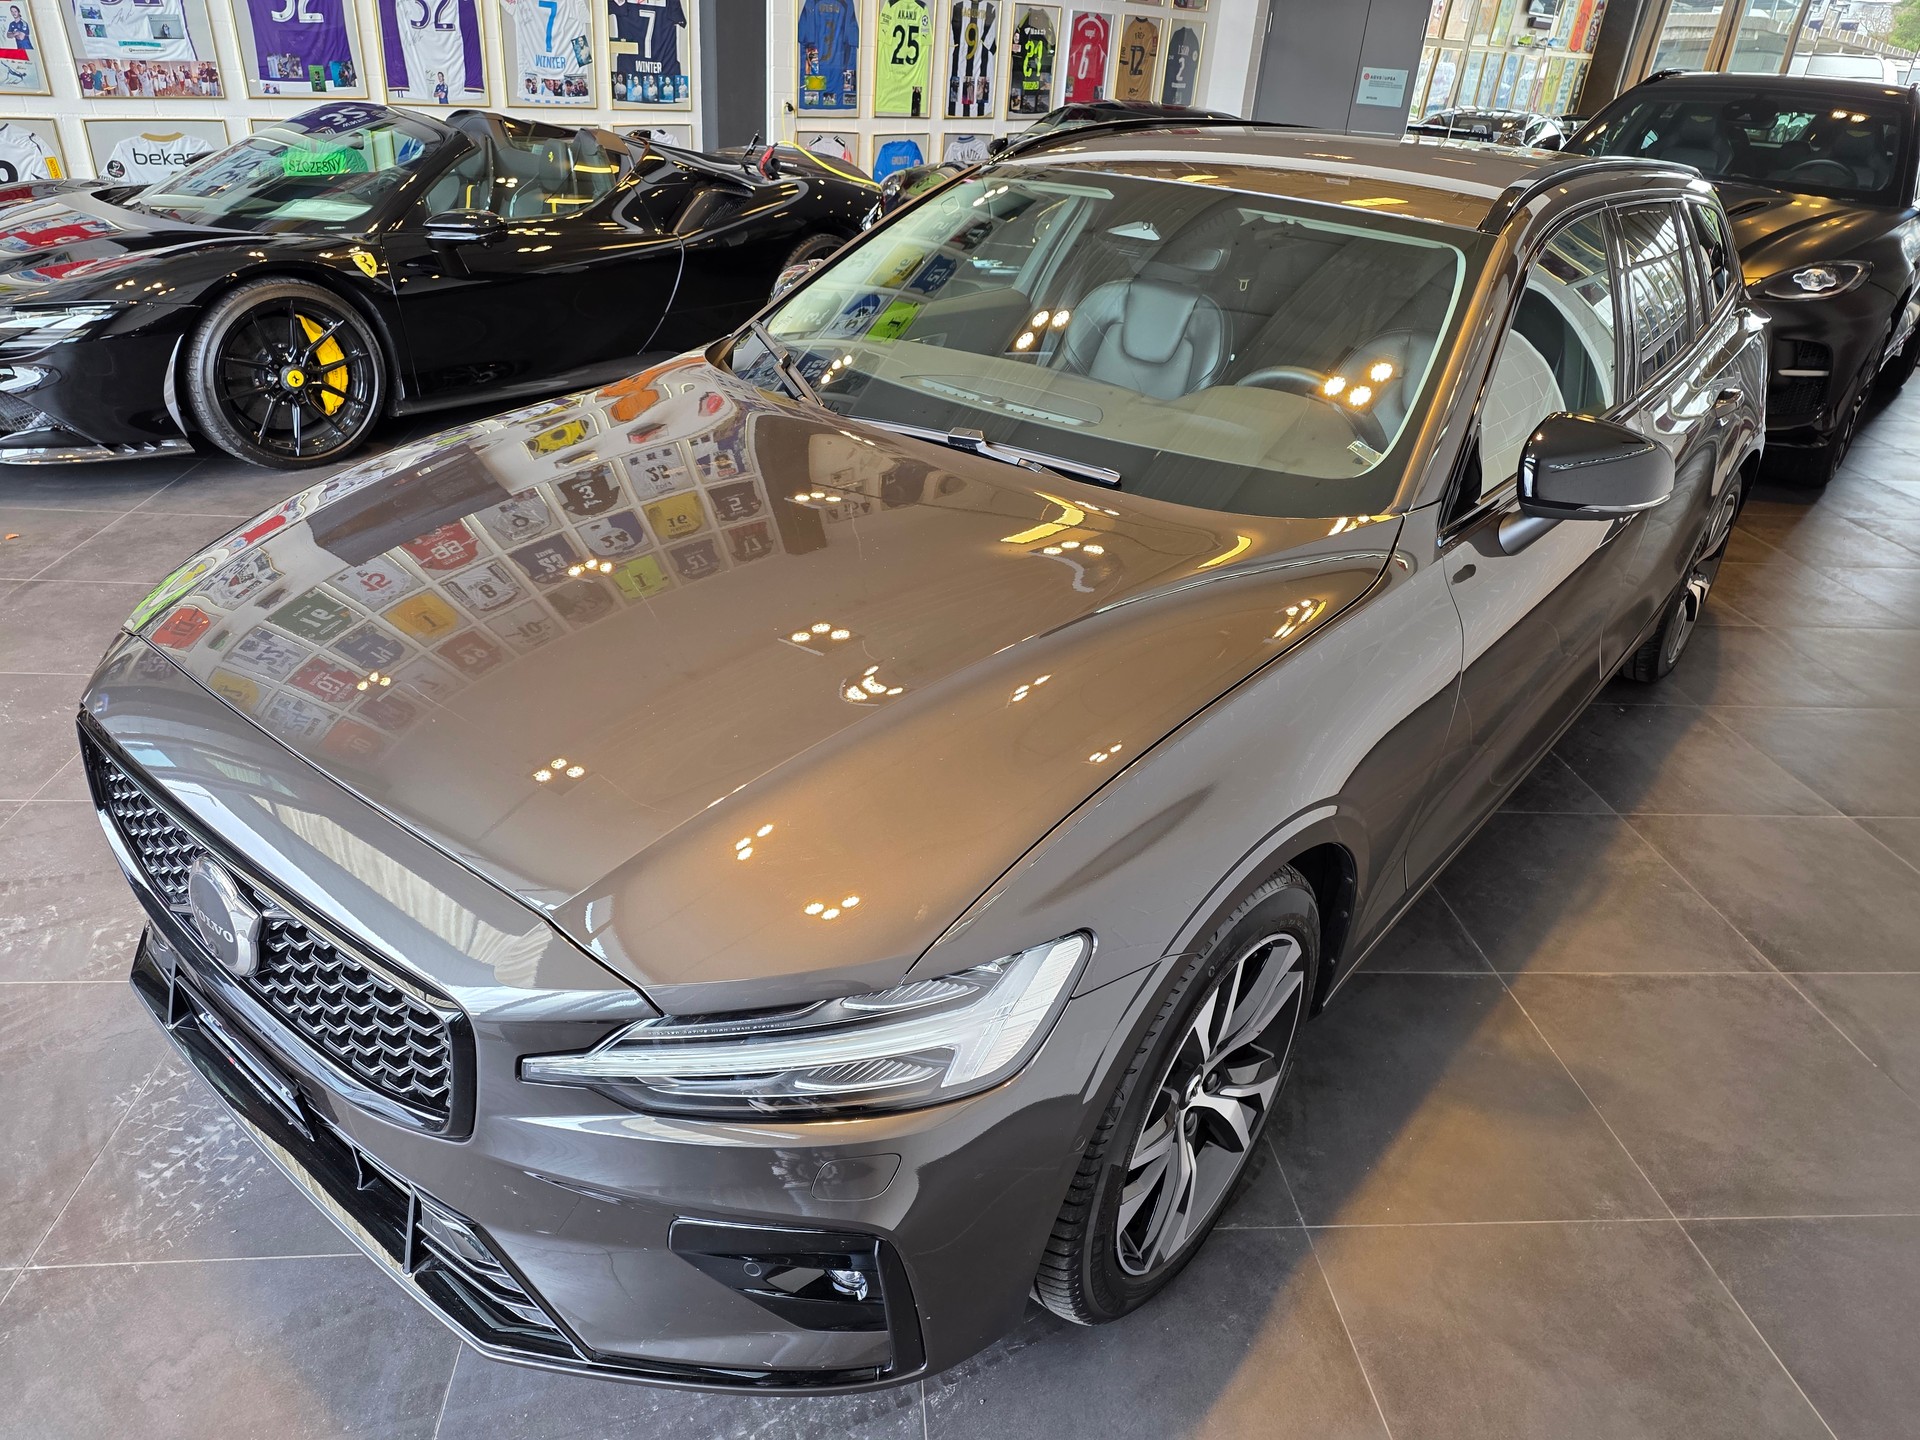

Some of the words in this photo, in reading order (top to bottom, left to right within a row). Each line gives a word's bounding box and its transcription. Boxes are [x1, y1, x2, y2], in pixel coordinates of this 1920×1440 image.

[539, 1, 558, 53] 7
[639, 9, 656, 59] 7
[891, 25, 920, 66] 25
[965, 22, 979, 60] 9
[535, 54, 566, 70] WINTER
[635, 60, 662, 74] WINTER
[1023, 40, 1044, 78] 21
[1077, 43, 1093, 80] 6
[1129, 45, 1145, 76] 12
[1176, 57, 1186, 82] 2
[194, 904, 234, 944] VOLVO
